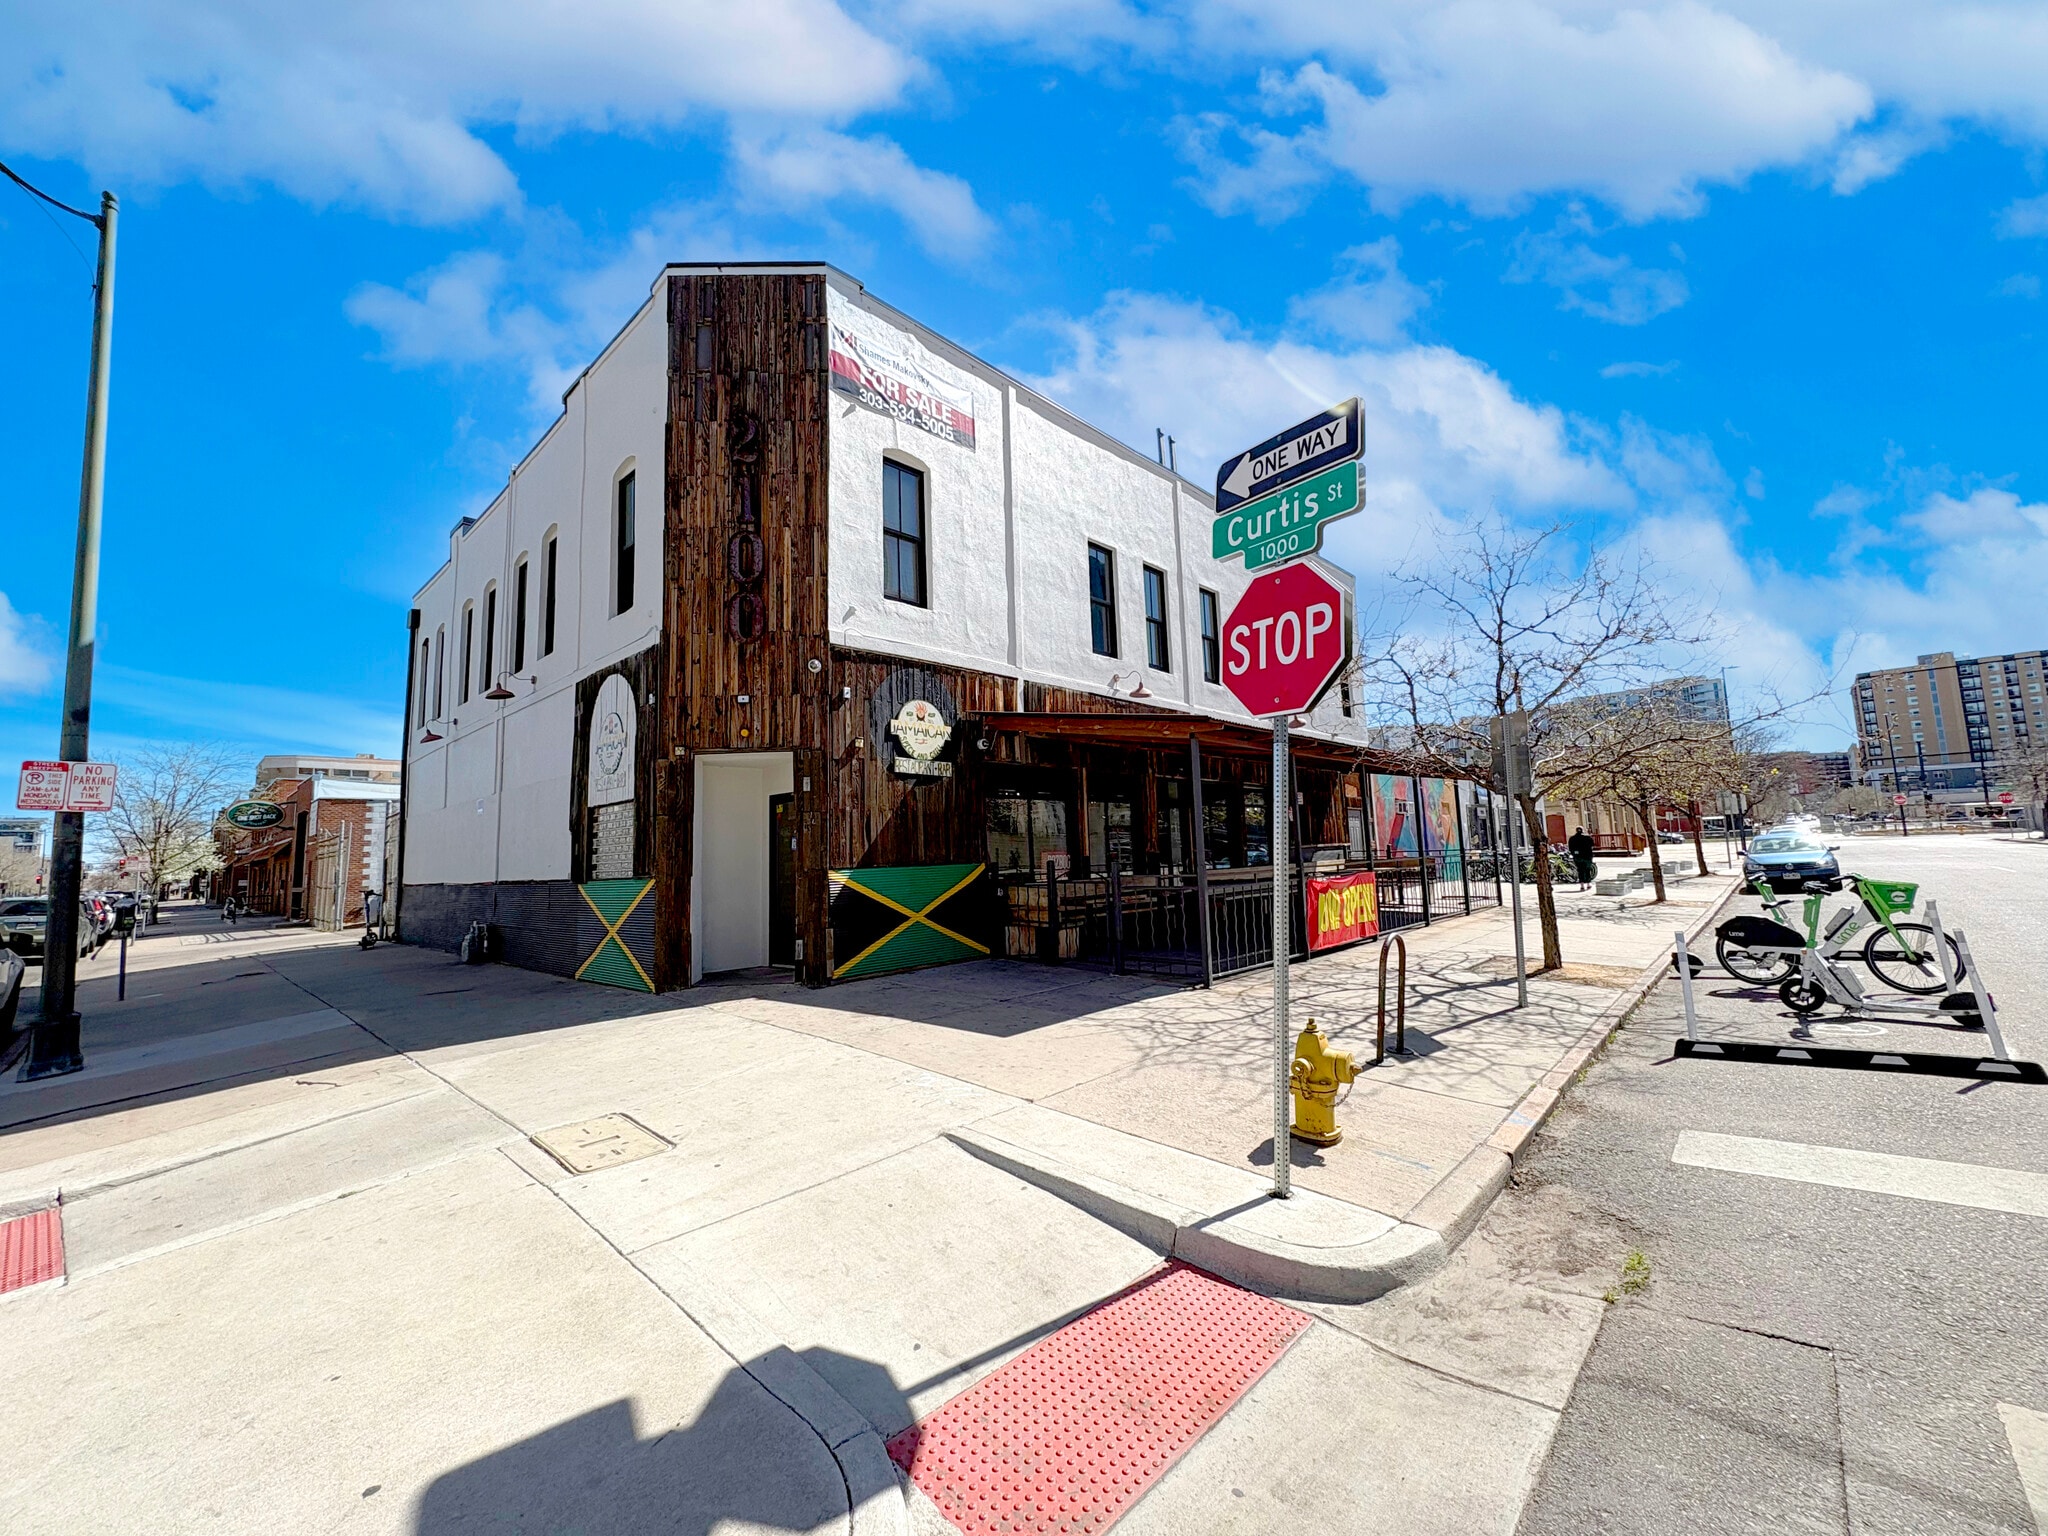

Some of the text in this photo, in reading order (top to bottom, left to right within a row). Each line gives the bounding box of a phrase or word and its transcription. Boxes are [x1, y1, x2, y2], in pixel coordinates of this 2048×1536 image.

[859, 344, 930, 387] Shames Makovsky
[859, 362, 953, 426] FOR SALE
[858, 389, 955, 442] 303-534-5005
[1252, 422, 1341, 481] ONE WAY
[1227, 481, 1343, 547] Curtis St
[1260, 534, 1299, 562] 1000
[1228, 602, 1334, 677] STOP
[890, 719, 952, 739] JAMAICAN
[900, 736, 916, 756] SPICE
[73, 775, 113, 786] PARKING
[85, 766, 102, 775] NO
[1833, 921, 1860, 945] Lime
